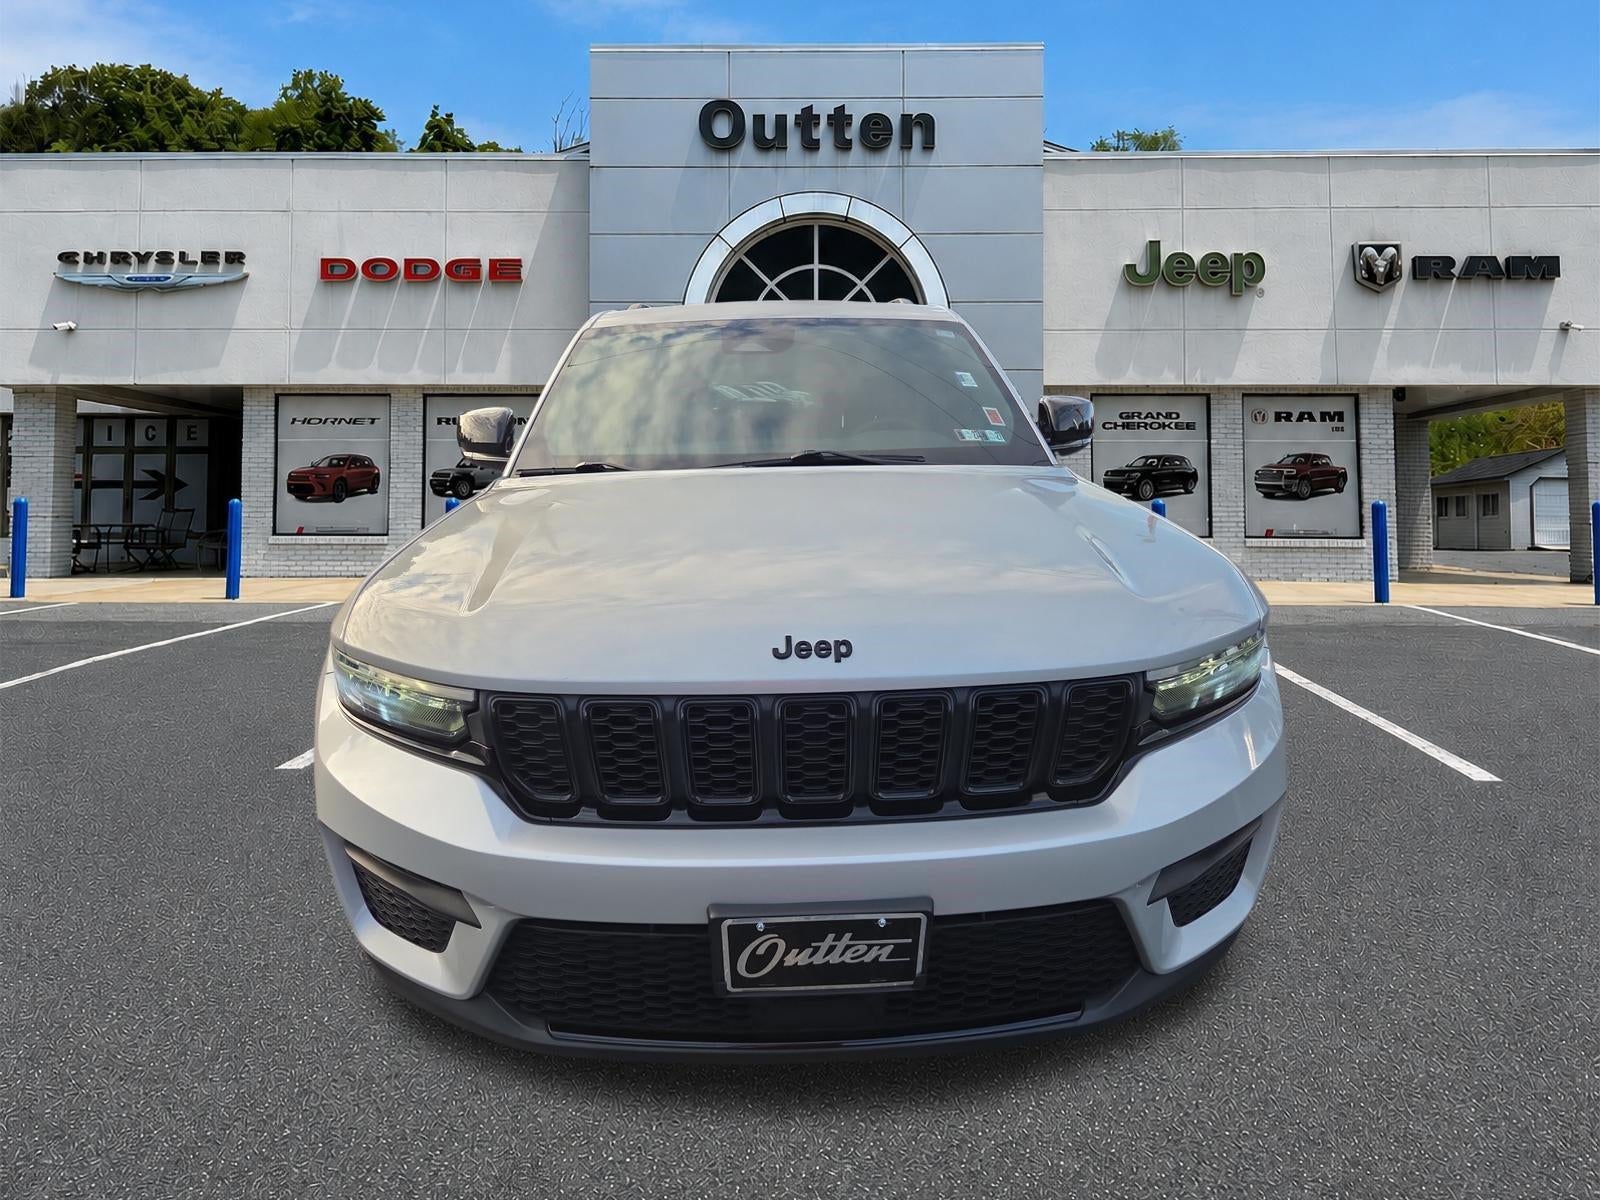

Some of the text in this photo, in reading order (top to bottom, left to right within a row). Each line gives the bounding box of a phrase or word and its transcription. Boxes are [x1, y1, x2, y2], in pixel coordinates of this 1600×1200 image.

[699, 99, 936, 151] Outten
[57, 250, 247, 266] CHRYSLER
[319, 257, 523, 282] DODGE
[1123, 240, 1266, 296] Jeep
[1412, 255, 1561, 280] RAM
[290, 417, 381, 426] HORNET
[1101, 421, 1197, 431] CHEROKEE
[1118, 411, 1181, 420] GRAND
[1274, 410, 1345, 423] RAM
[771, 635, 853, 663] Jeep
[736, 932, 913, 979] Outten
